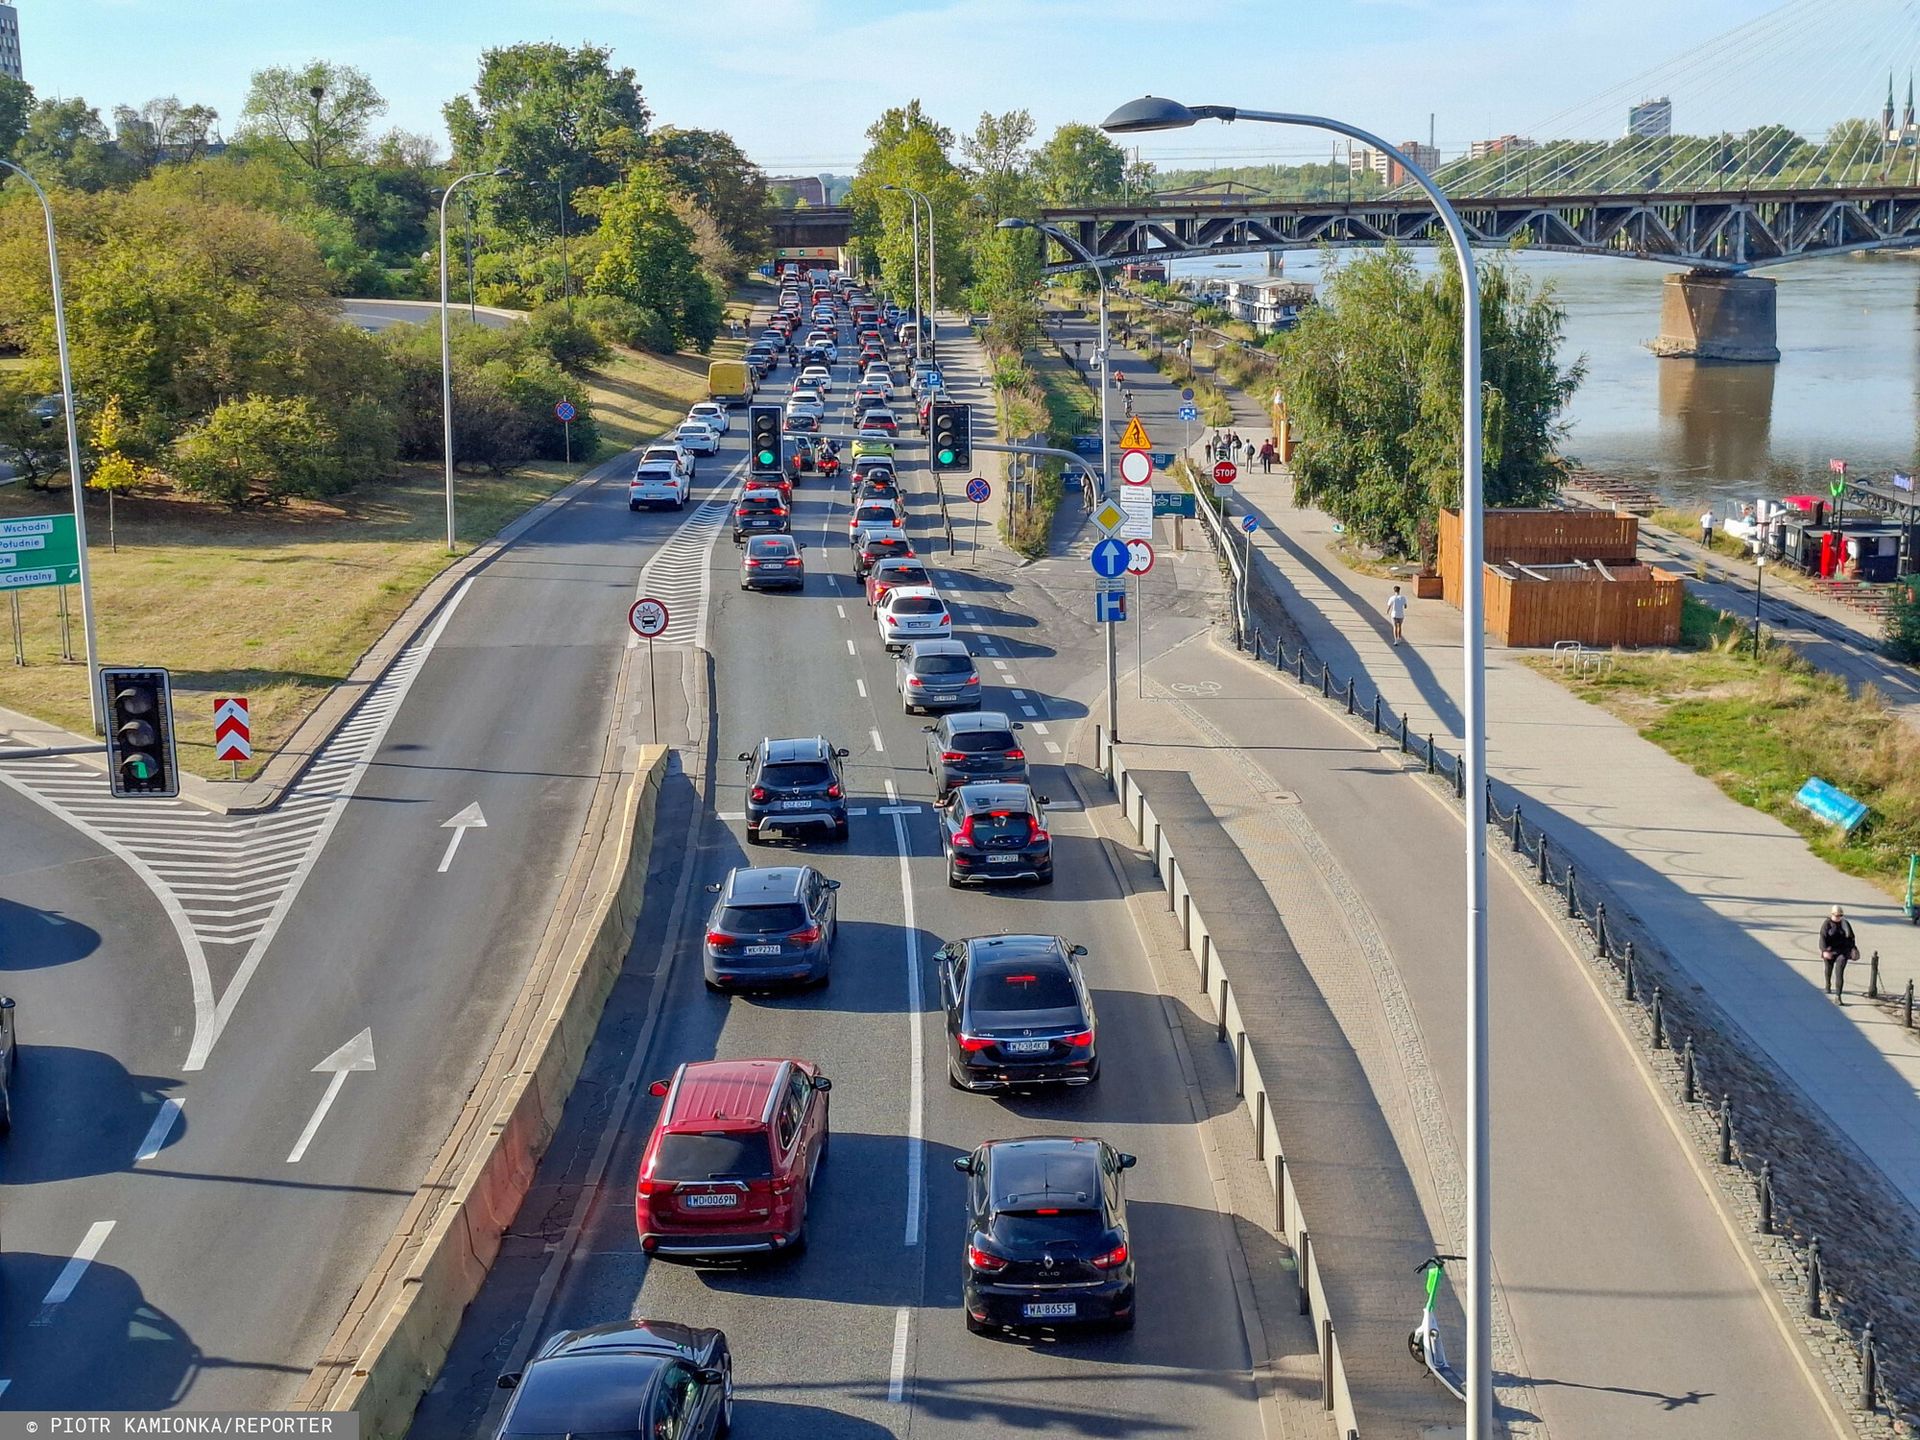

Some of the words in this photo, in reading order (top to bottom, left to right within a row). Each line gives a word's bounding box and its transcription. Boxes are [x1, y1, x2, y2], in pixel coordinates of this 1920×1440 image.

[1214, 468, 1236, 478] STOP
[4, 522, 49, 533] Wschodni
[5, 573, 52, 583] Centralny
[1030, 1305, 1042, 1315] WA
[1045, 1304, 1073, 1314] 8655F
